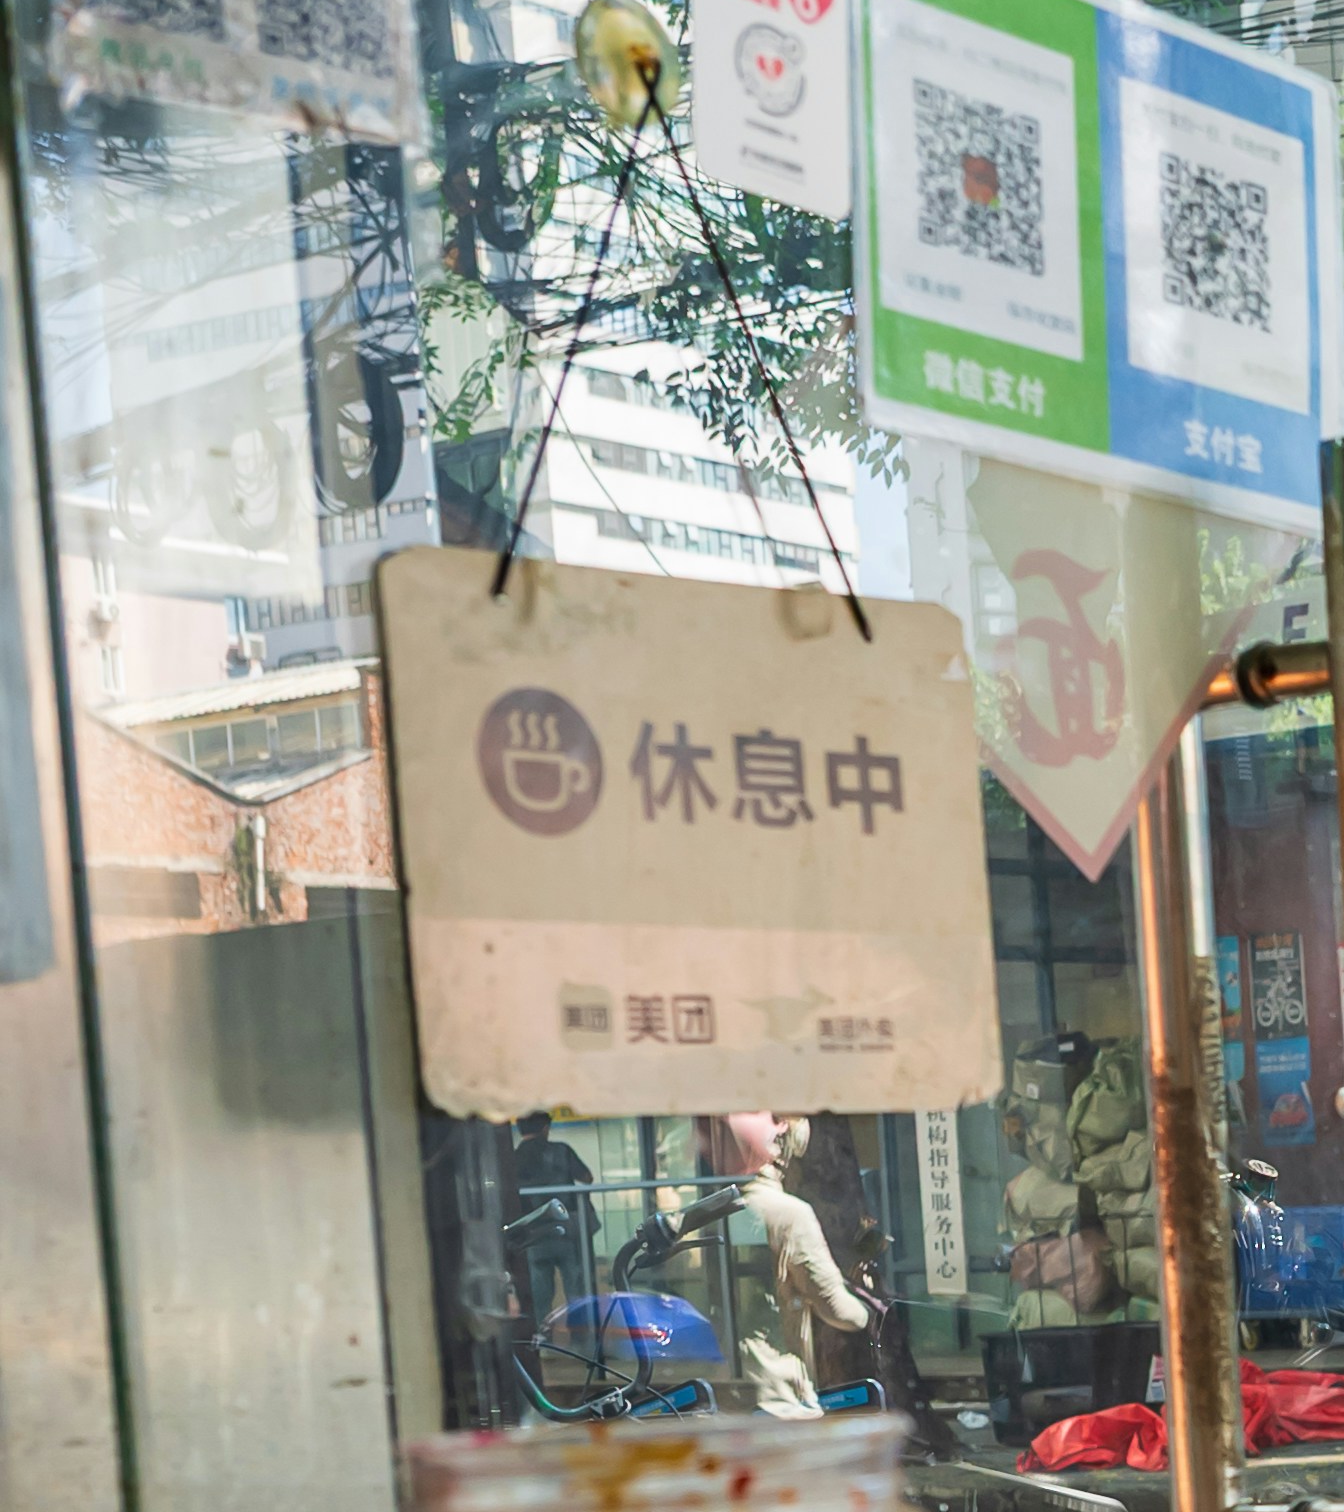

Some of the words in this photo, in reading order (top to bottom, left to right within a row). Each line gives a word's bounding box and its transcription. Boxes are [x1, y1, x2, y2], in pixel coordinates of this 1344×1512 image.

[923, 350, 1046, 418] 微信支付
[1183, 419, 1264, 475] 支付宝
[628, 720, 905, 836] 休息中
[625, 994, 718, 1045] 美团
